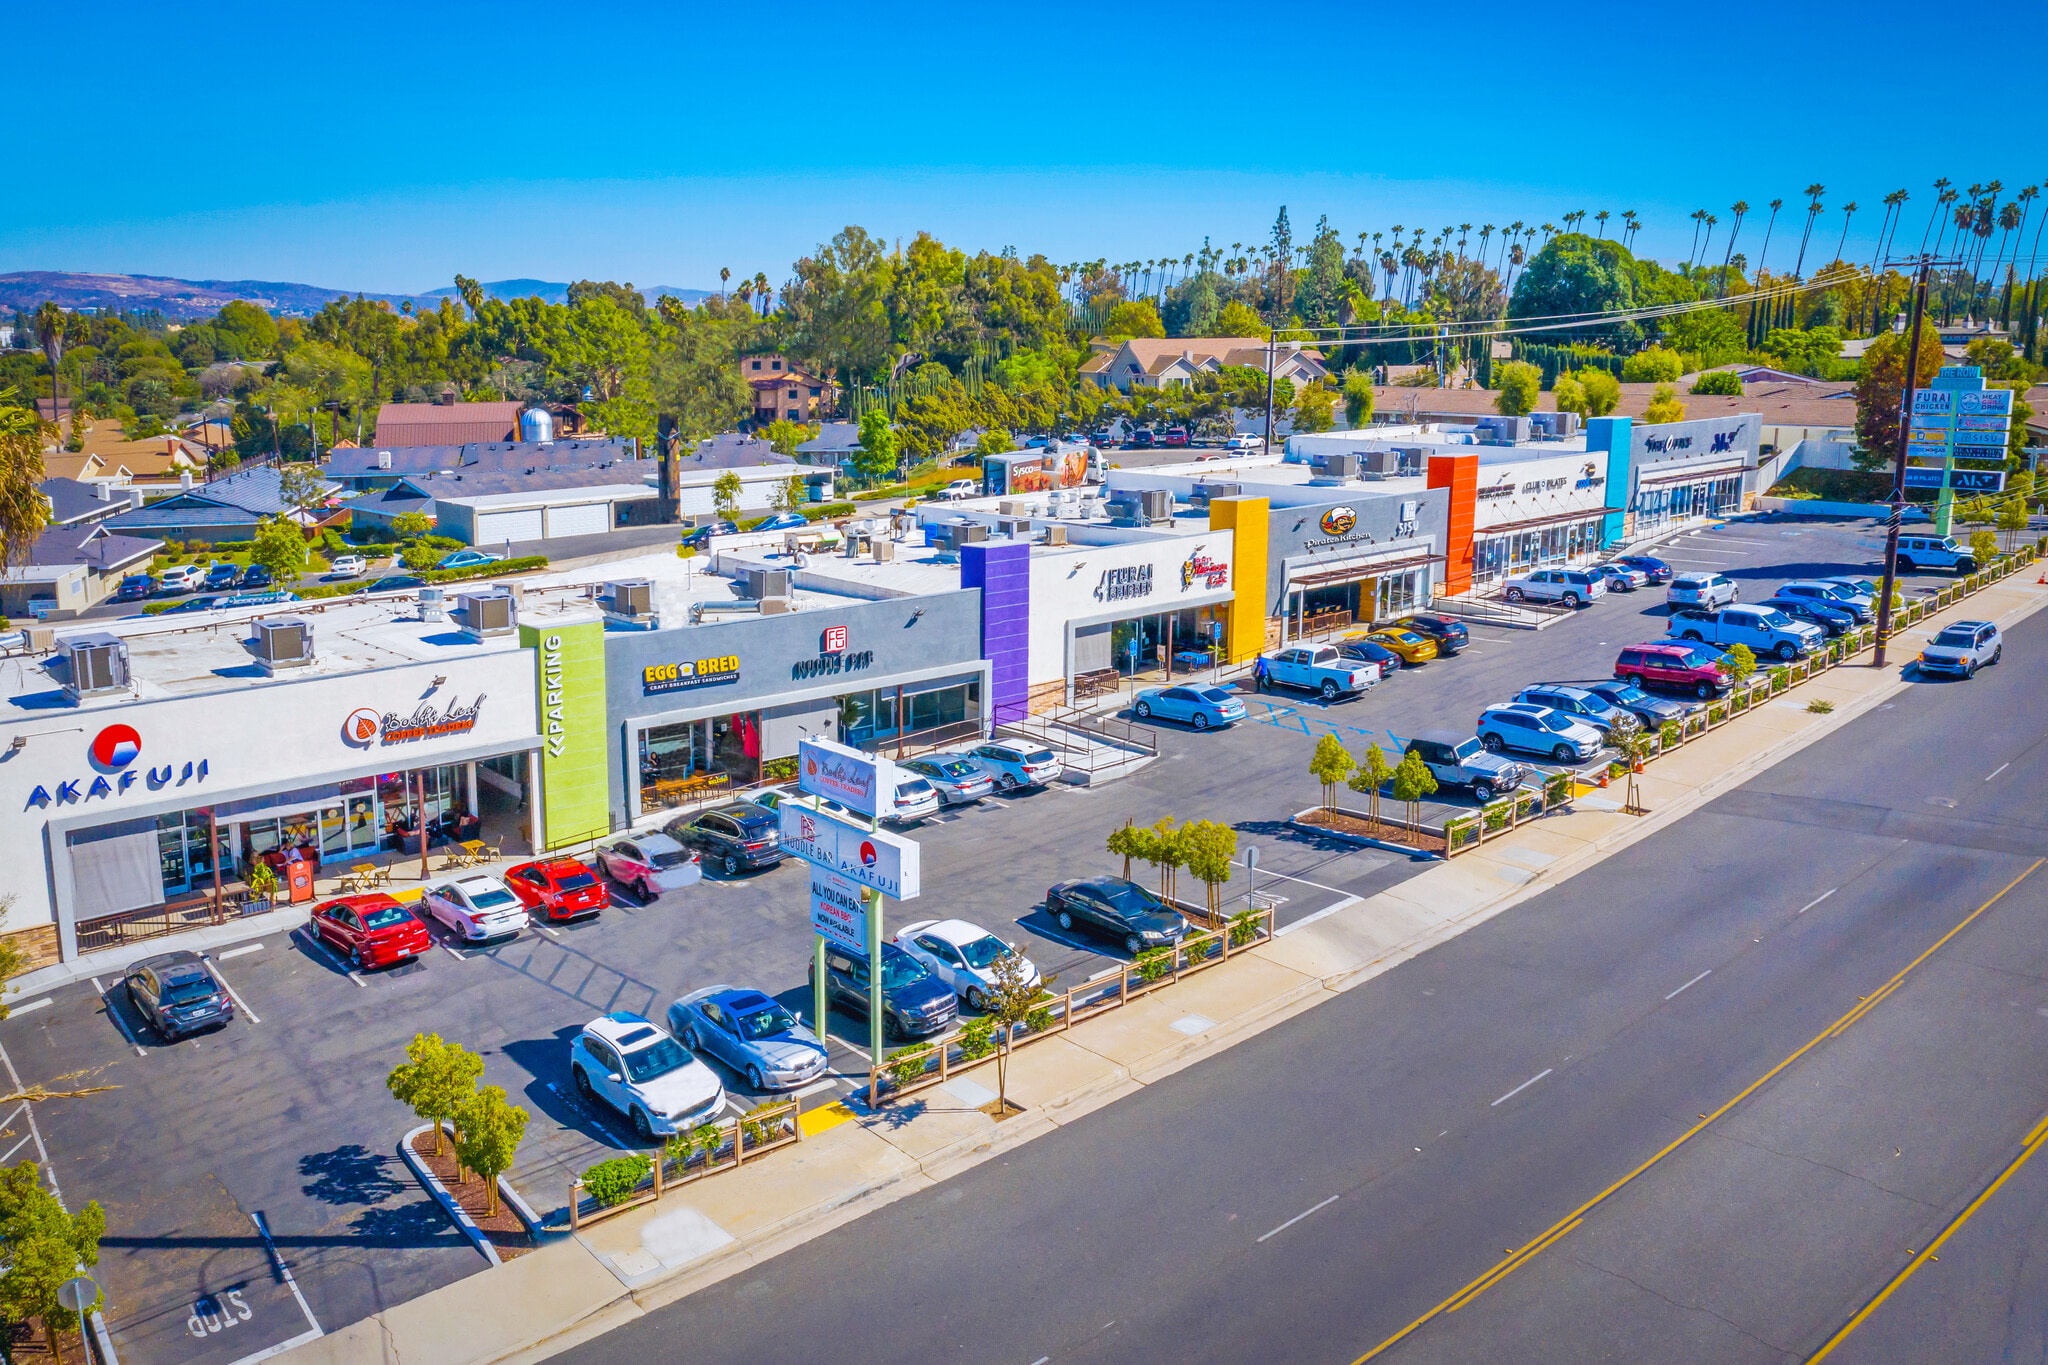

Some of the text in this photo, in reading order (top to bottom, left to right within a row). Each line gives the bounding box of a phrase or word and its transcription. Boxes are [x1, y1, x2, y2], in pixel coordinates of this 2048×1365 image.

[1941, 368, 1978, 378] THE ROW
[1916, 393, 1951, 402] FURAI
[1524, 477, 1568, 490] CLUB PILATES
[1340, 532, 1371, 542] Kitchen
[1399, 521, 1419, 534] SISU
[1110, 564, 1153, 584] FURAI
[645, 655, 740, 682] EGG BRED
[546, 635, 565, 735] PARKING
[670, 679, 701, 688] BREAKFAST
[702, 675, 737, 684] SANDWICHES
[386, 693, 488, 732] Bodhi Leaf
[385, 720, 474, 742] COFFEE TRADERS
[29, 759, 209, 805] AKAFUJI
[820, 776, 865, 797] COFFEE TRADERS
[784, 831, 834, 864] NOODLE BAR
[841, 861, 898, 893] AKAFUJI
[812, 881, 823, 898] ALL
[823, 885, 835, 903] YOU
[835, 890, 848, 909] CAN
[820, 902, 840, 919] KOREAN
[817, 912, 829, 925] NOW
[830, 919, 855, 938] AVAILABLE
[188, 1290, 253, 1338] STOP
